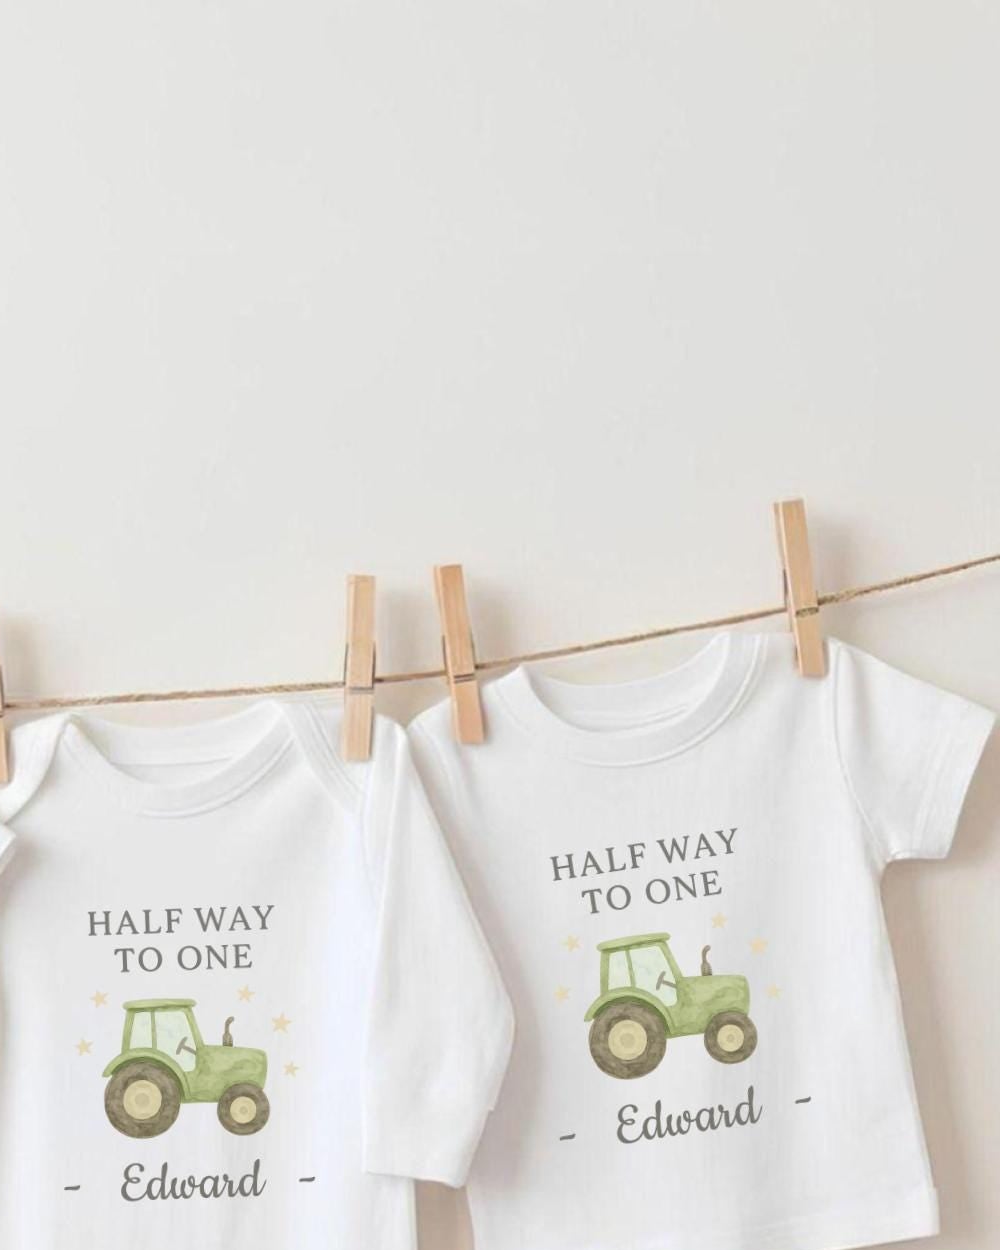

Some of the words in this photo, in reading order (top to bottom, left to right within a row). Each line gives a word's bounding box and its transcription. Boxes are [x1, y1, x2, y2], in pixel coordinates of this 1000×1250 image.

[550, 842, 646, 881] HALF
[656, 827, 738, 864] WAY
[581, 884, 632, 914] TO
[645, 870, 722, 904] ONE
[88, 908, 183, 936] HALF
[194, 904, 275, 932] WAY
[113, 946, 163, 973] TO
[177, 943, 253, 971] ONE
[616, 1085, 763, 1144] Edward
[121, 1158, 267, 1202] Edward
